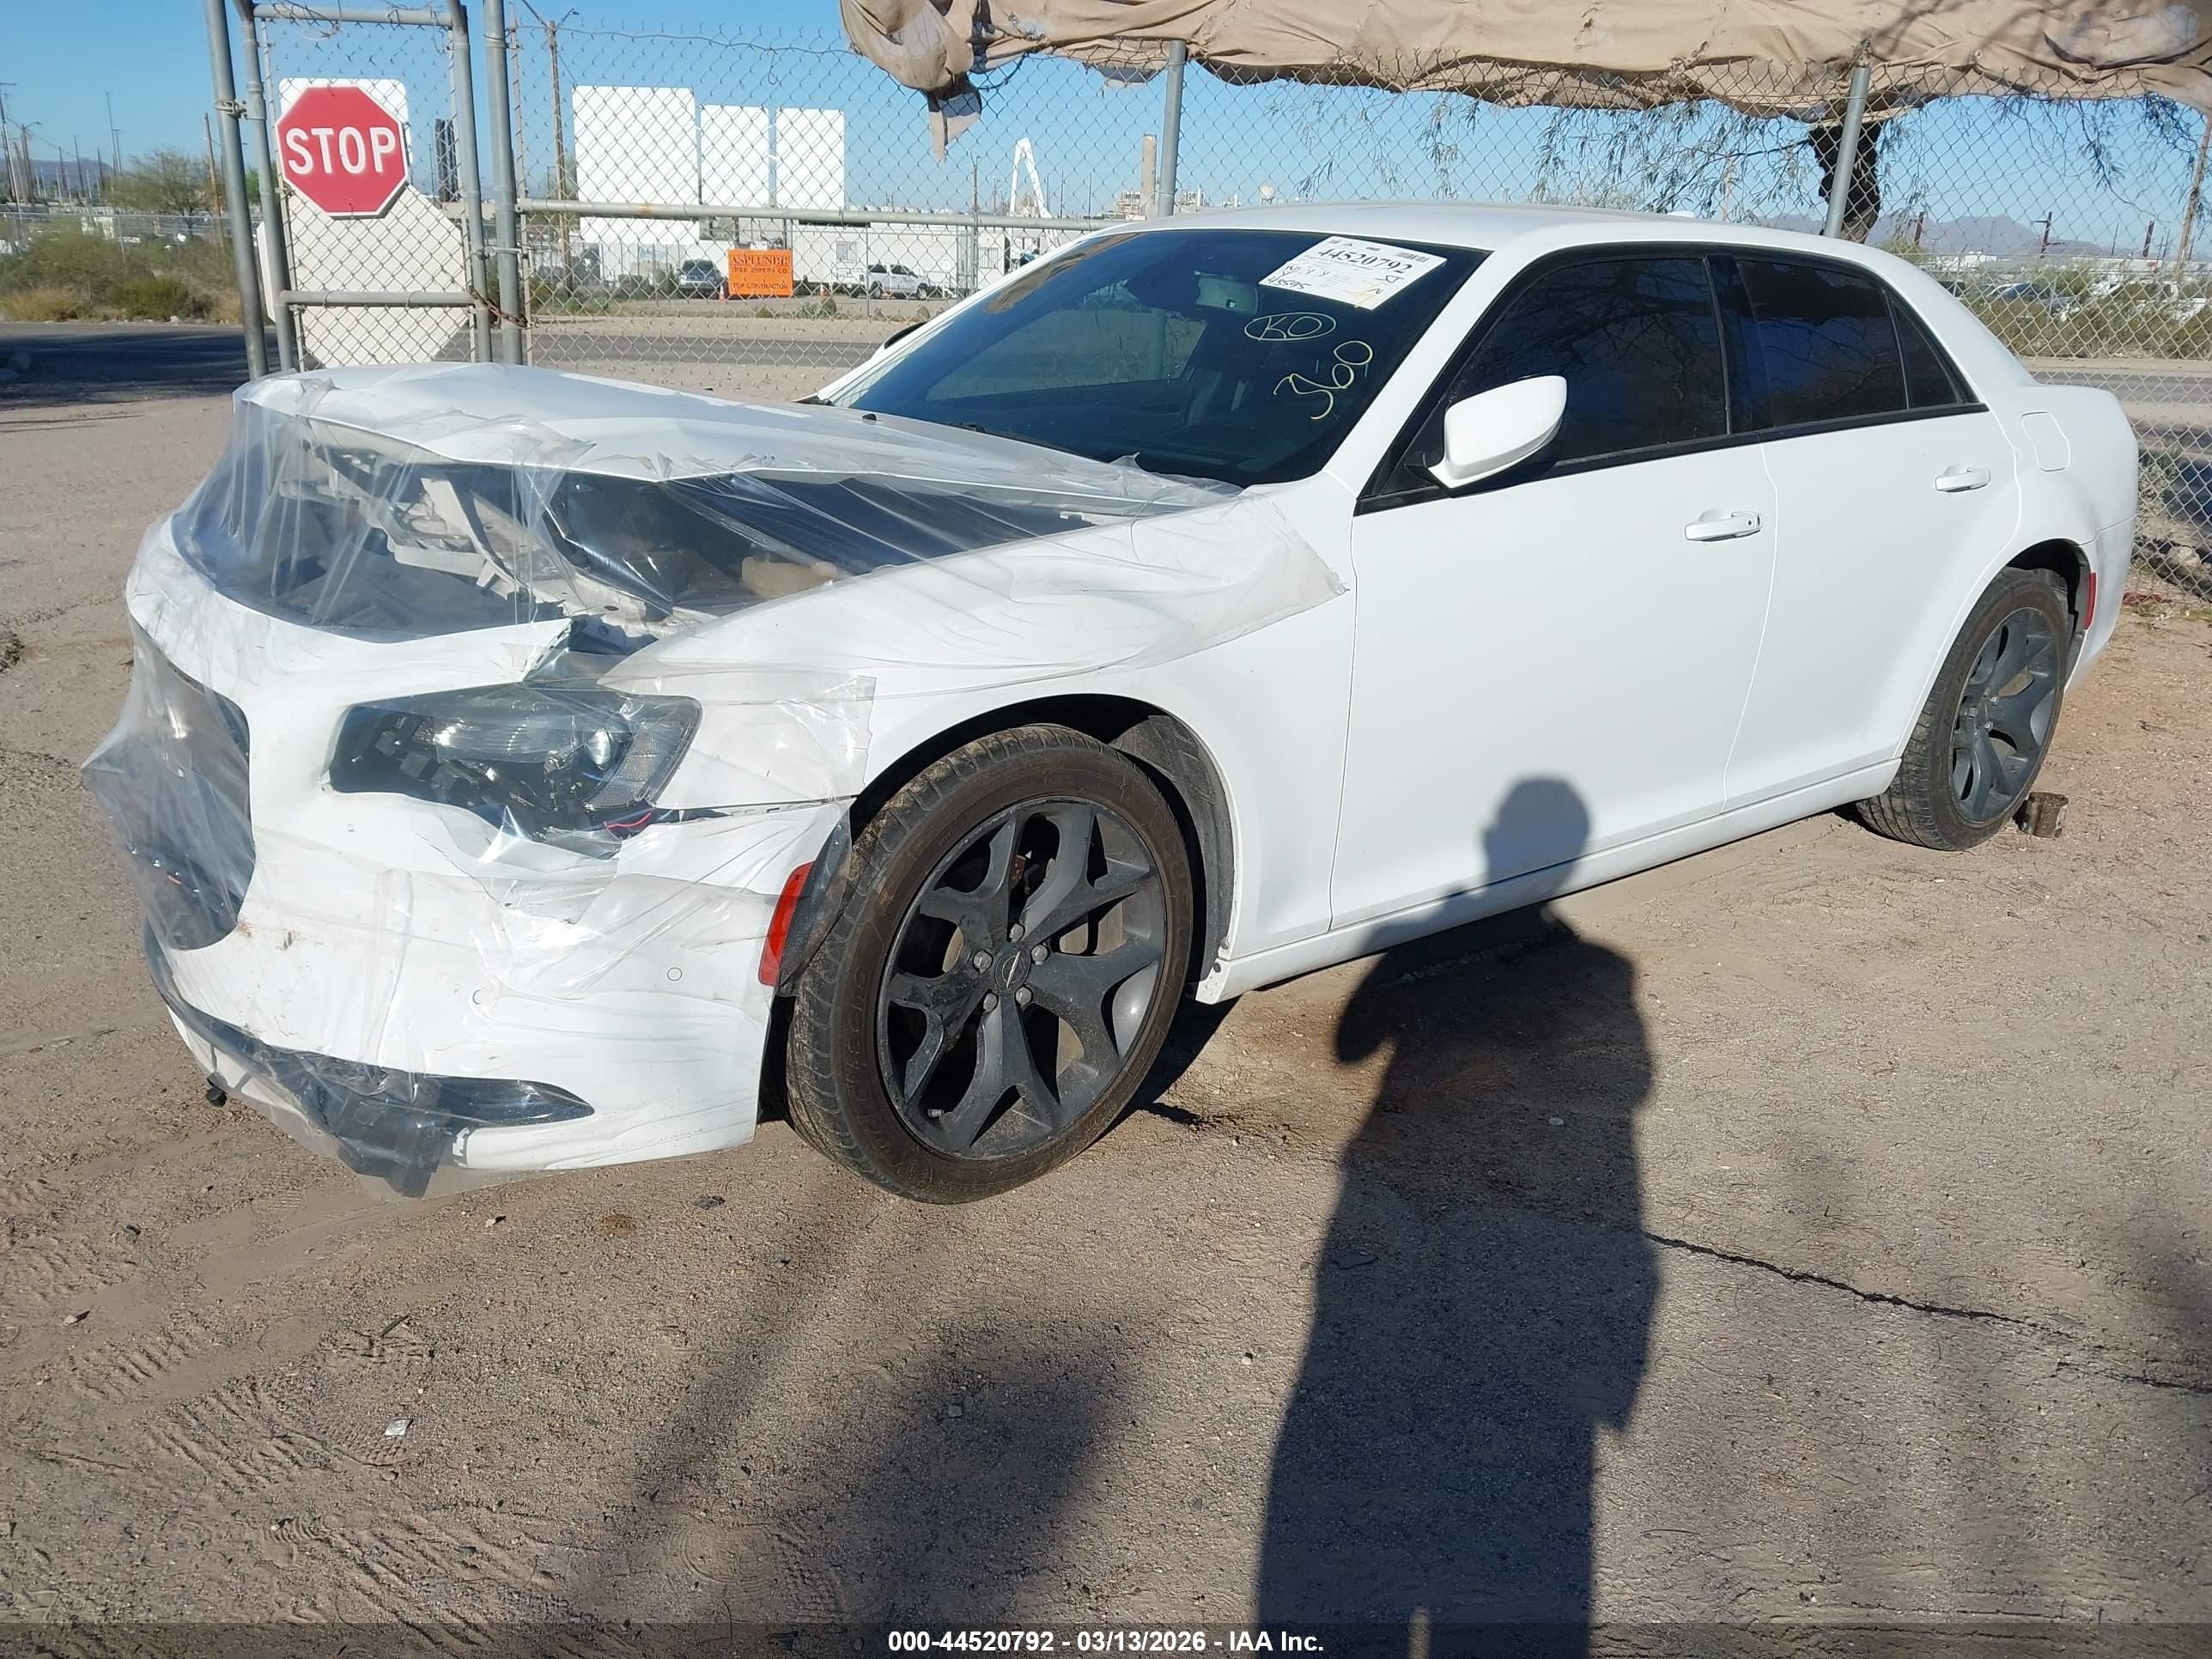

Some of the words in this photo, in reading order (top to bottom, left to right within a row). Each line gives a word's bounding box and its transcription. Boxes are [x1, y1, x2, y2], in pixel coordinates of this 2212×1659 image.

[286, 126, 396, 174] STOP
[1317, 247, 1413, 274] 44520792
[1257, 315, 1323, 341] KO
